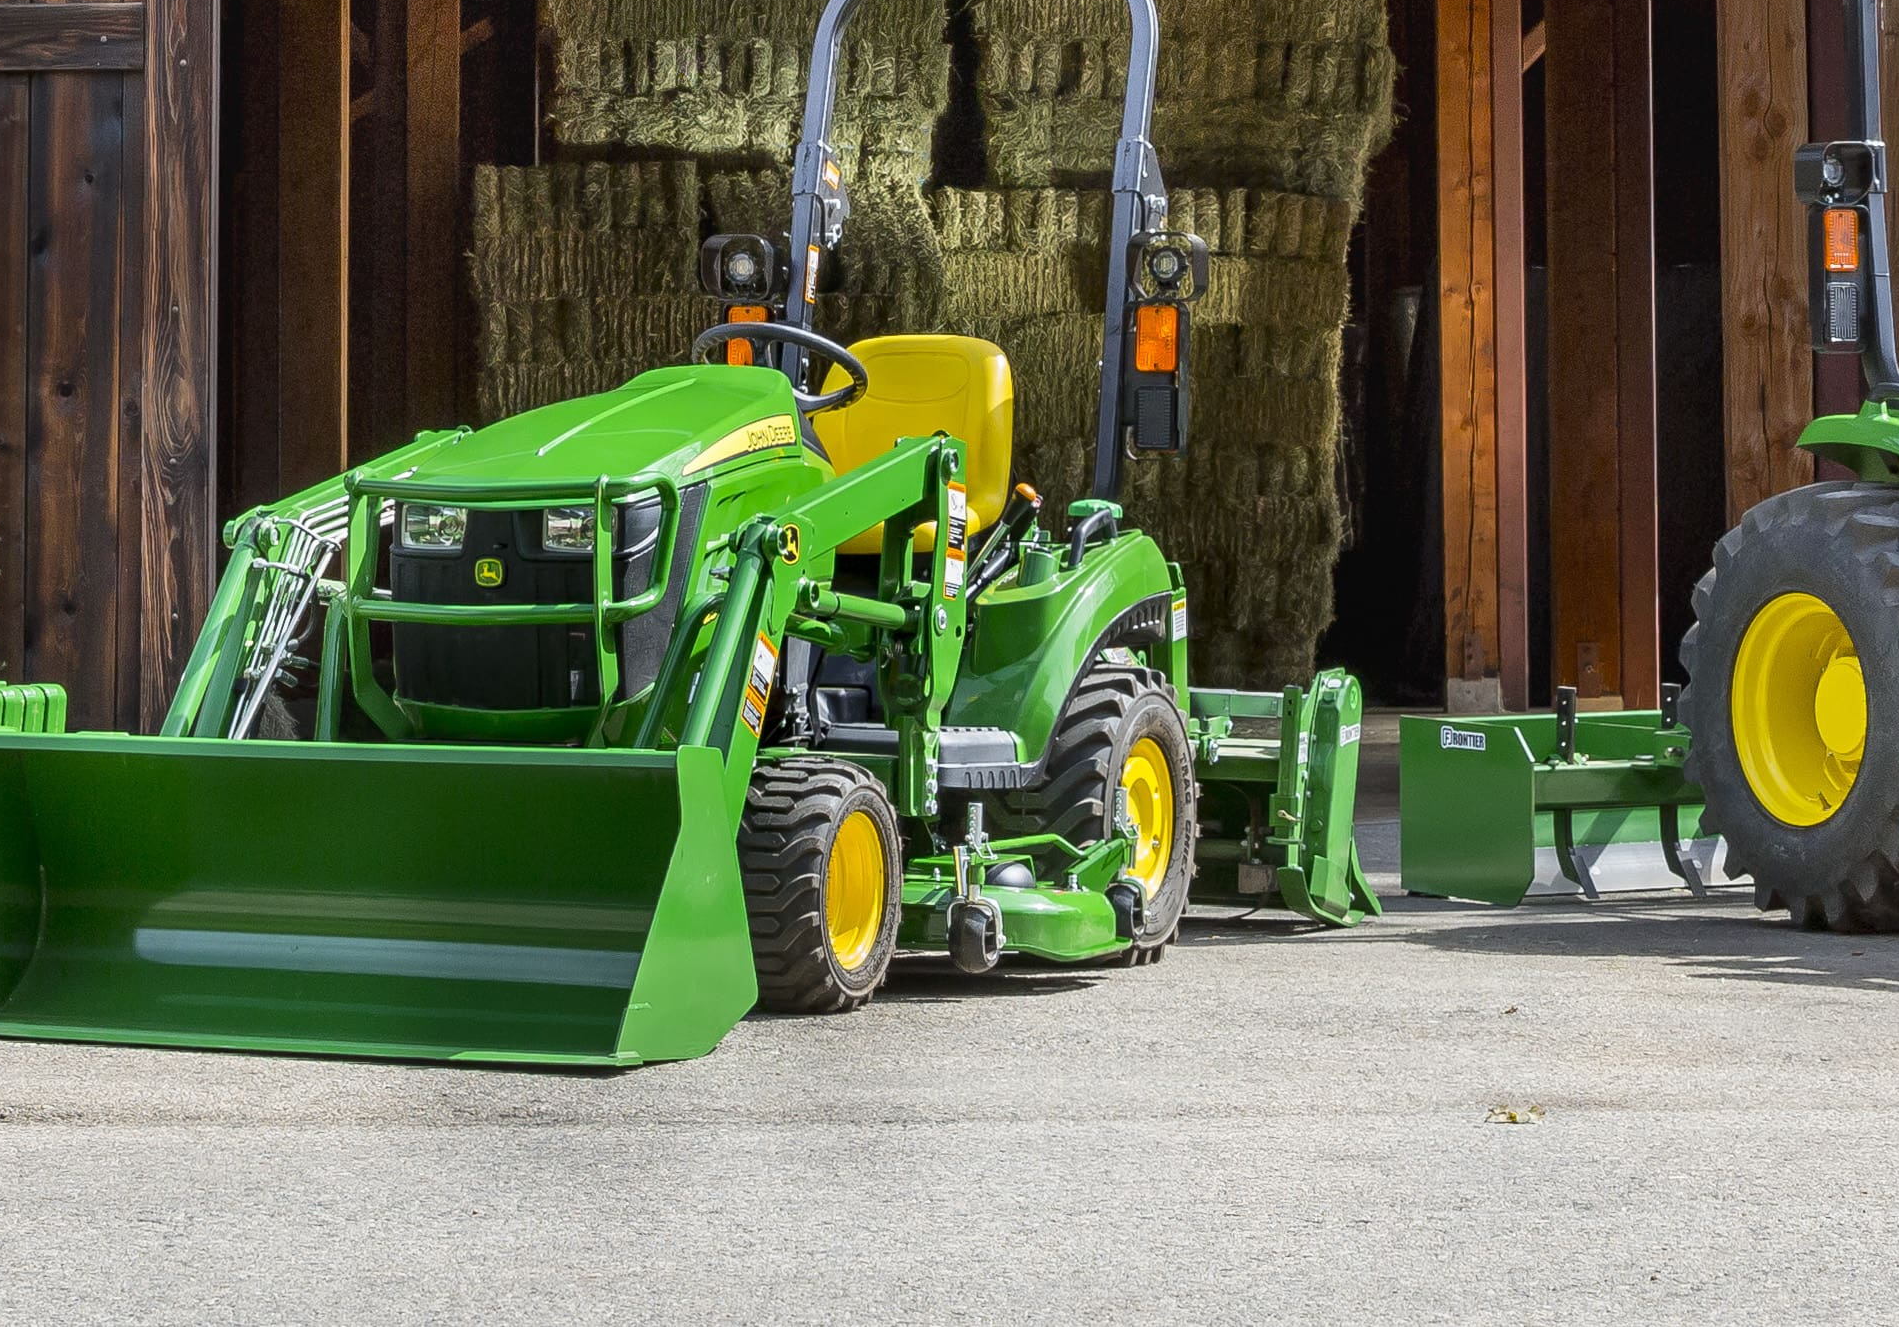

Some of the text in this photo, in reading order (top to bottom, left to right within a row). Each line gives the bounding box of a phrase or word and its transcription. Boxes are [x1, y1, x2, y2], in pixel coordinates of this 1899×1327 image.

[746, 429, 769, 448] JOHN
[1442, 727, 1485, 749] FRONTIER
[1180, 752, 1191, 804] TRAC
